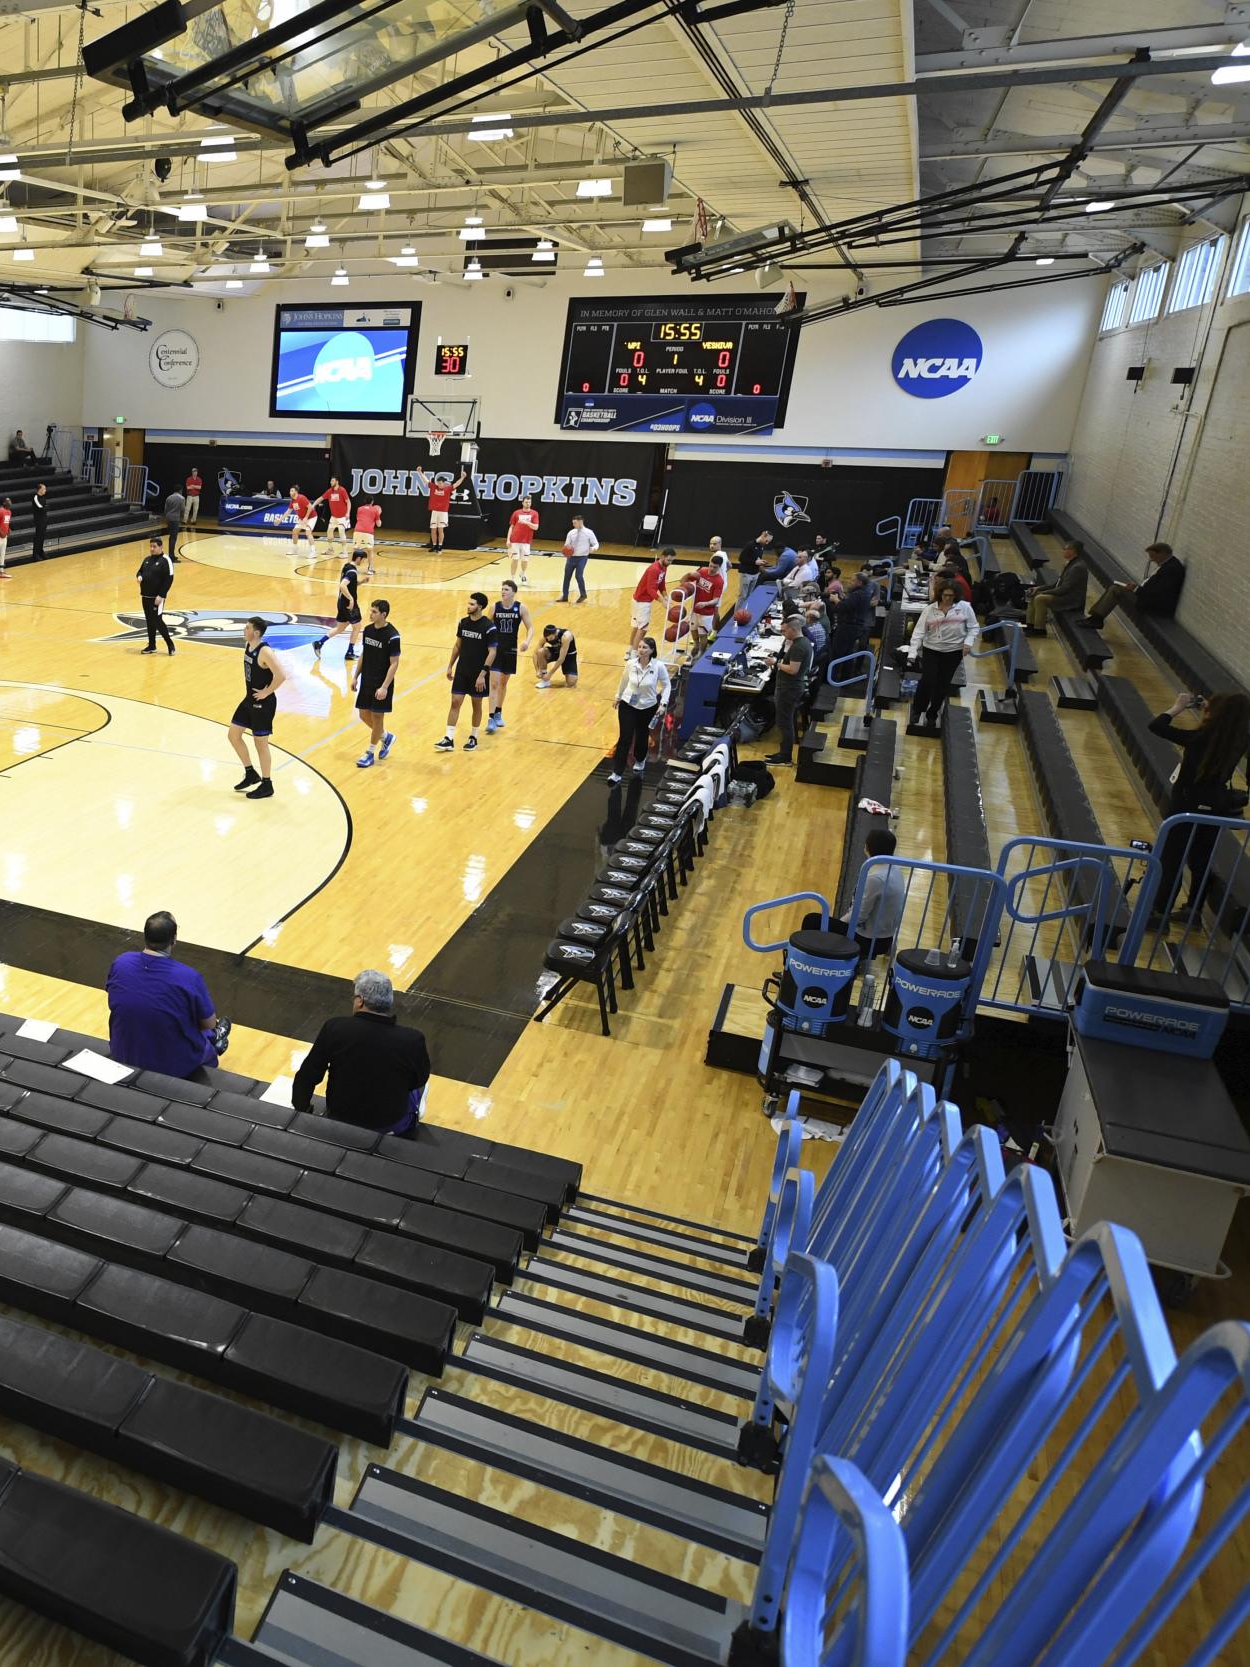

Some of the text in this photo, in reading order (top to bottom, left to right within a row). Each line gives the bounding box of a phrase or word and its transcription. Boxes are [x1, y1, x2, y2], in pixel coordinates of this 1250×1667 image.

[591, 310, 630, 318] MEMORY
[660, 324, 701, 340] 15:55
[442, 346, 464, 356] 15:55
[702, 342, 733, 350] YESHIVA
[441, 356, 460, 372] 30
[633, 352, 644, 368] 0
[718, 352, 730, 368] 0
[897, 358, 977, 378] NCAA
[620, 374, 629, 386] 0
[638, 374, 646, 386] 4
[694, 375, 704, 386] 4
[716, 374, 726, 387] 0
[582, 382, 590, 392] 0
[752, 384, 761, 394] 0
[470, 472, 638, 506] HOPKINS
[500, 619, 513, 632] 11
[462, 629, 482, 640] YESHIVA
[790, 958, 853, 978] POWERADE
[894, 976, 962, 999] POWERADE
[802, 994, 828, 1005] NCAA
[908, 1016, 934, 1026] NCAA
[1104, 1006, 1200, 1032] POWERADE
